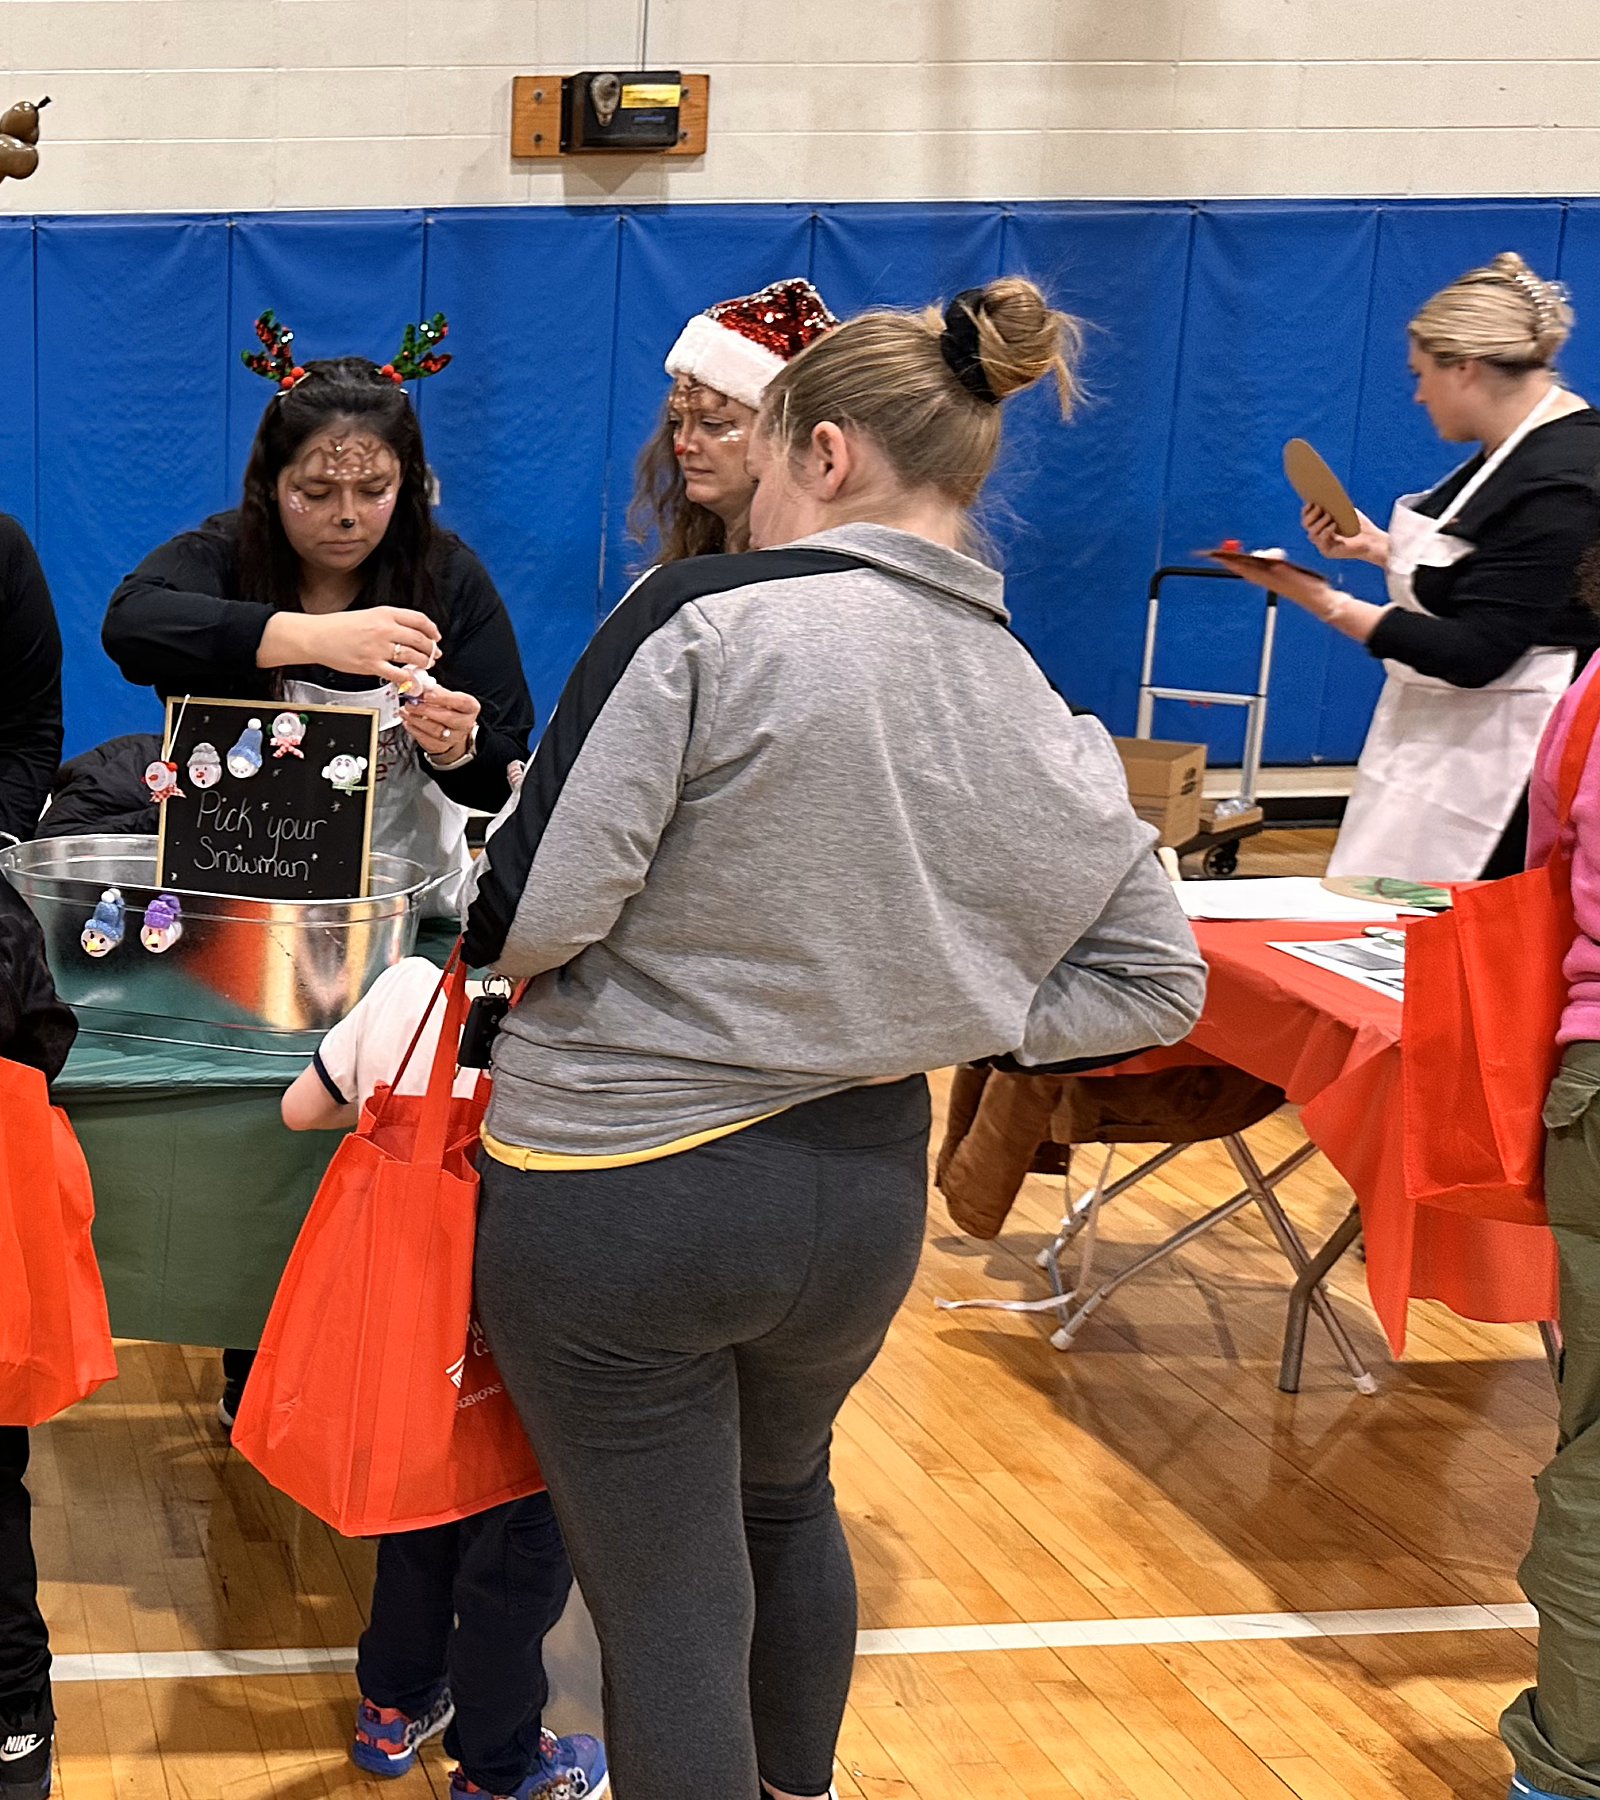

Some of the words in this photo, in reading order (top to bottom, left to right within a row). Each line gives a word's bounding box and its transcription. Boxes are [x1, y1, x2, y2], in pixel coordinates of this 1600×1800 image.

[196, 790, 253, 838] Pick
[267, 816, 328, 858] your
[193, 836, 309, 881] Snowman
[4, 1733, 37, 1752] NIKE
